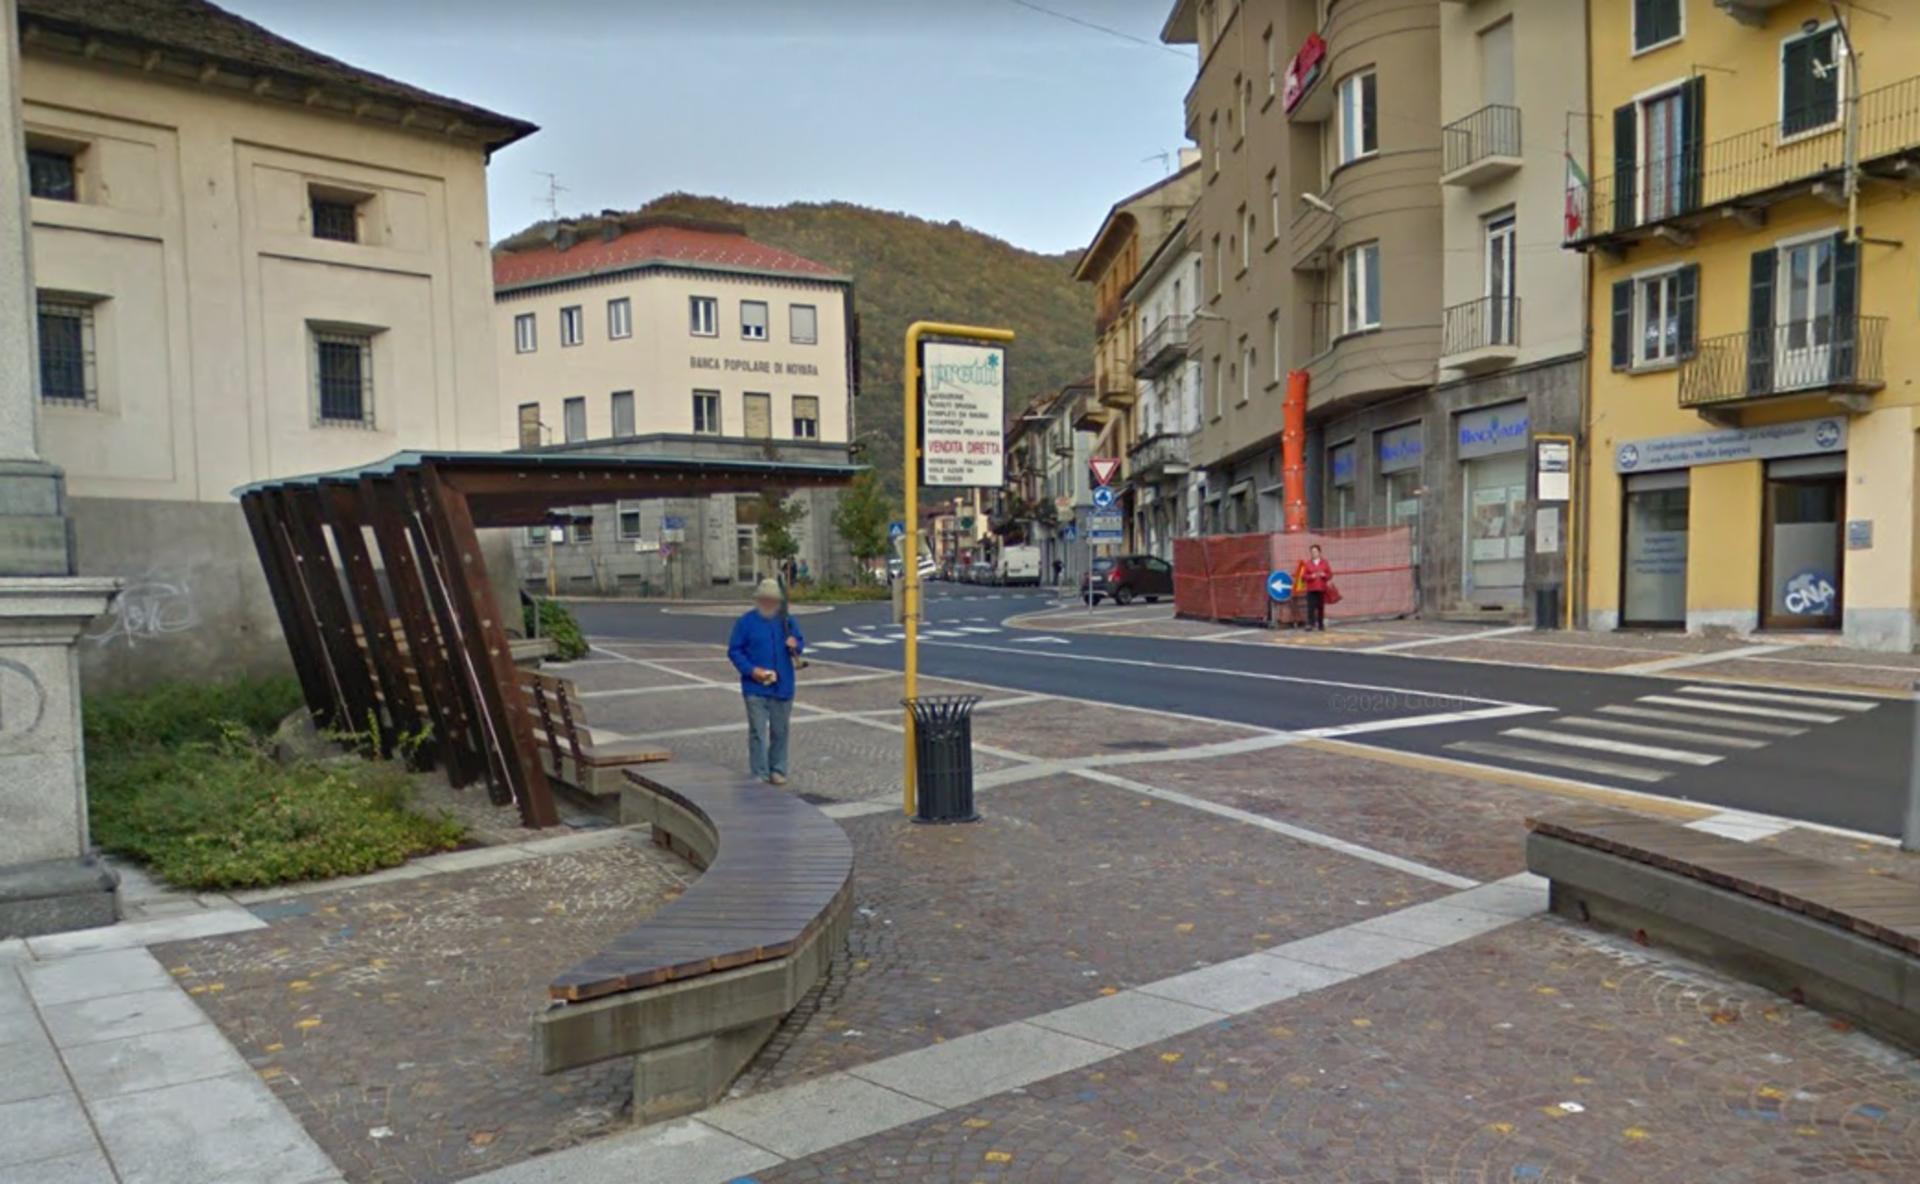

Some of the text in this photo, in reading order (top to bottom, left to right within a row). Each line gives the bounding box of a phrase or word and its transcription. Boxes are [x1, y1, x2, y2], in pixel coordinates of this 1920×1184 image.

[689, 356, 818, 376] BANCA POPOLARE DI NOVARA
[929, 441, 1000, 455] VENDITA DIRETTA
[1785, 580, 1835, 613] CNA
